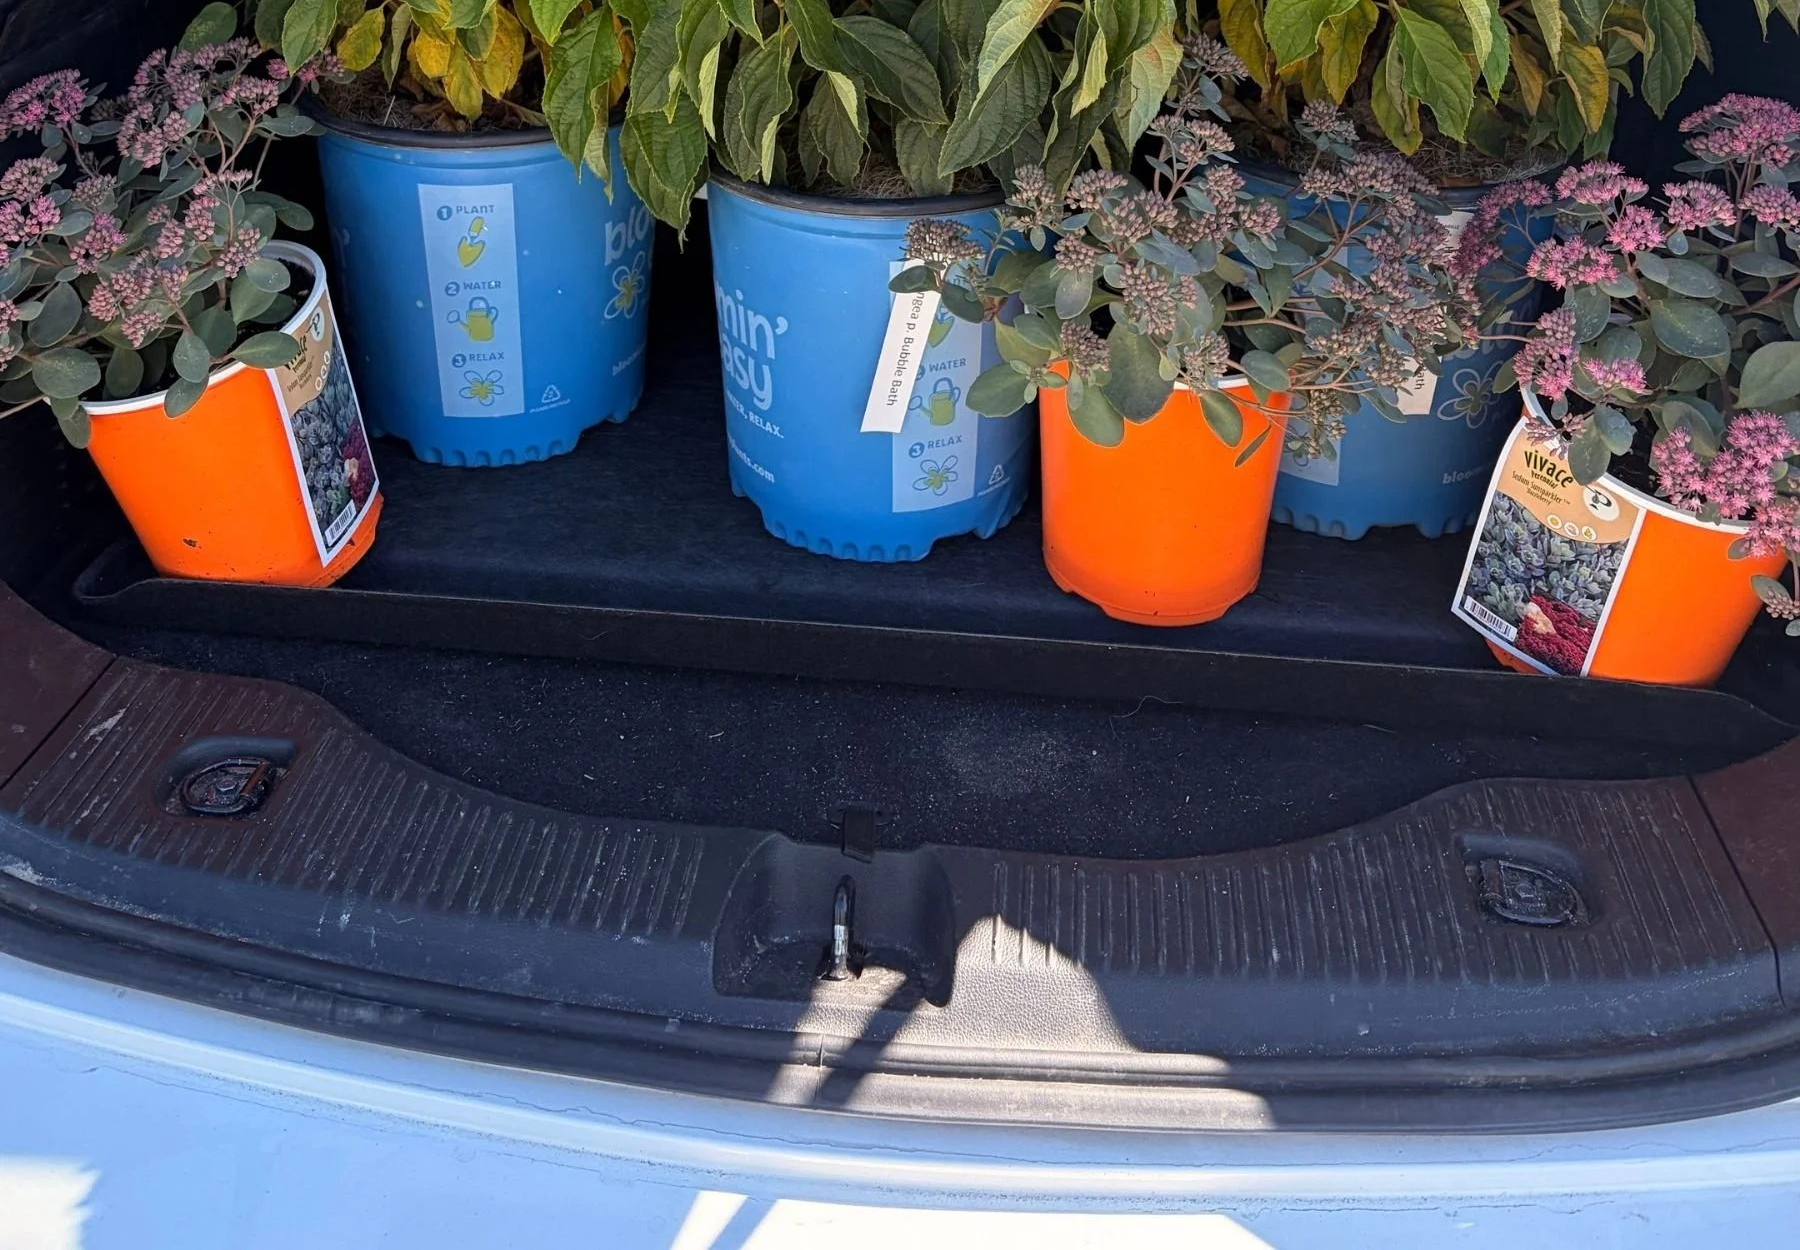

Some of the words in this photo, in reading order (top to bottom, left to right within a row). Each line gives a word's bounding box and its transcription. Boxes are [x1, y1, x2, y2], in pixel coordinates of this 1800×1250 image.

[456, 205, 495, 215] PLANT
[463, 280, 502, 290] WATER
[905, 322, 917, 333] p.
[469, 352, 505, 362] RELAX
[894, 337, 915, 377] Bubble
[929, 358, 967, 372] WATER
[886, 380, 903, 406] Bath
[749, 411, 785, 439] RELAX.
[928, 435, 963, 449] RELAX
[1524, 450, 1574, 488] vivace
[1512, 471, 1530, 487] Sedum
